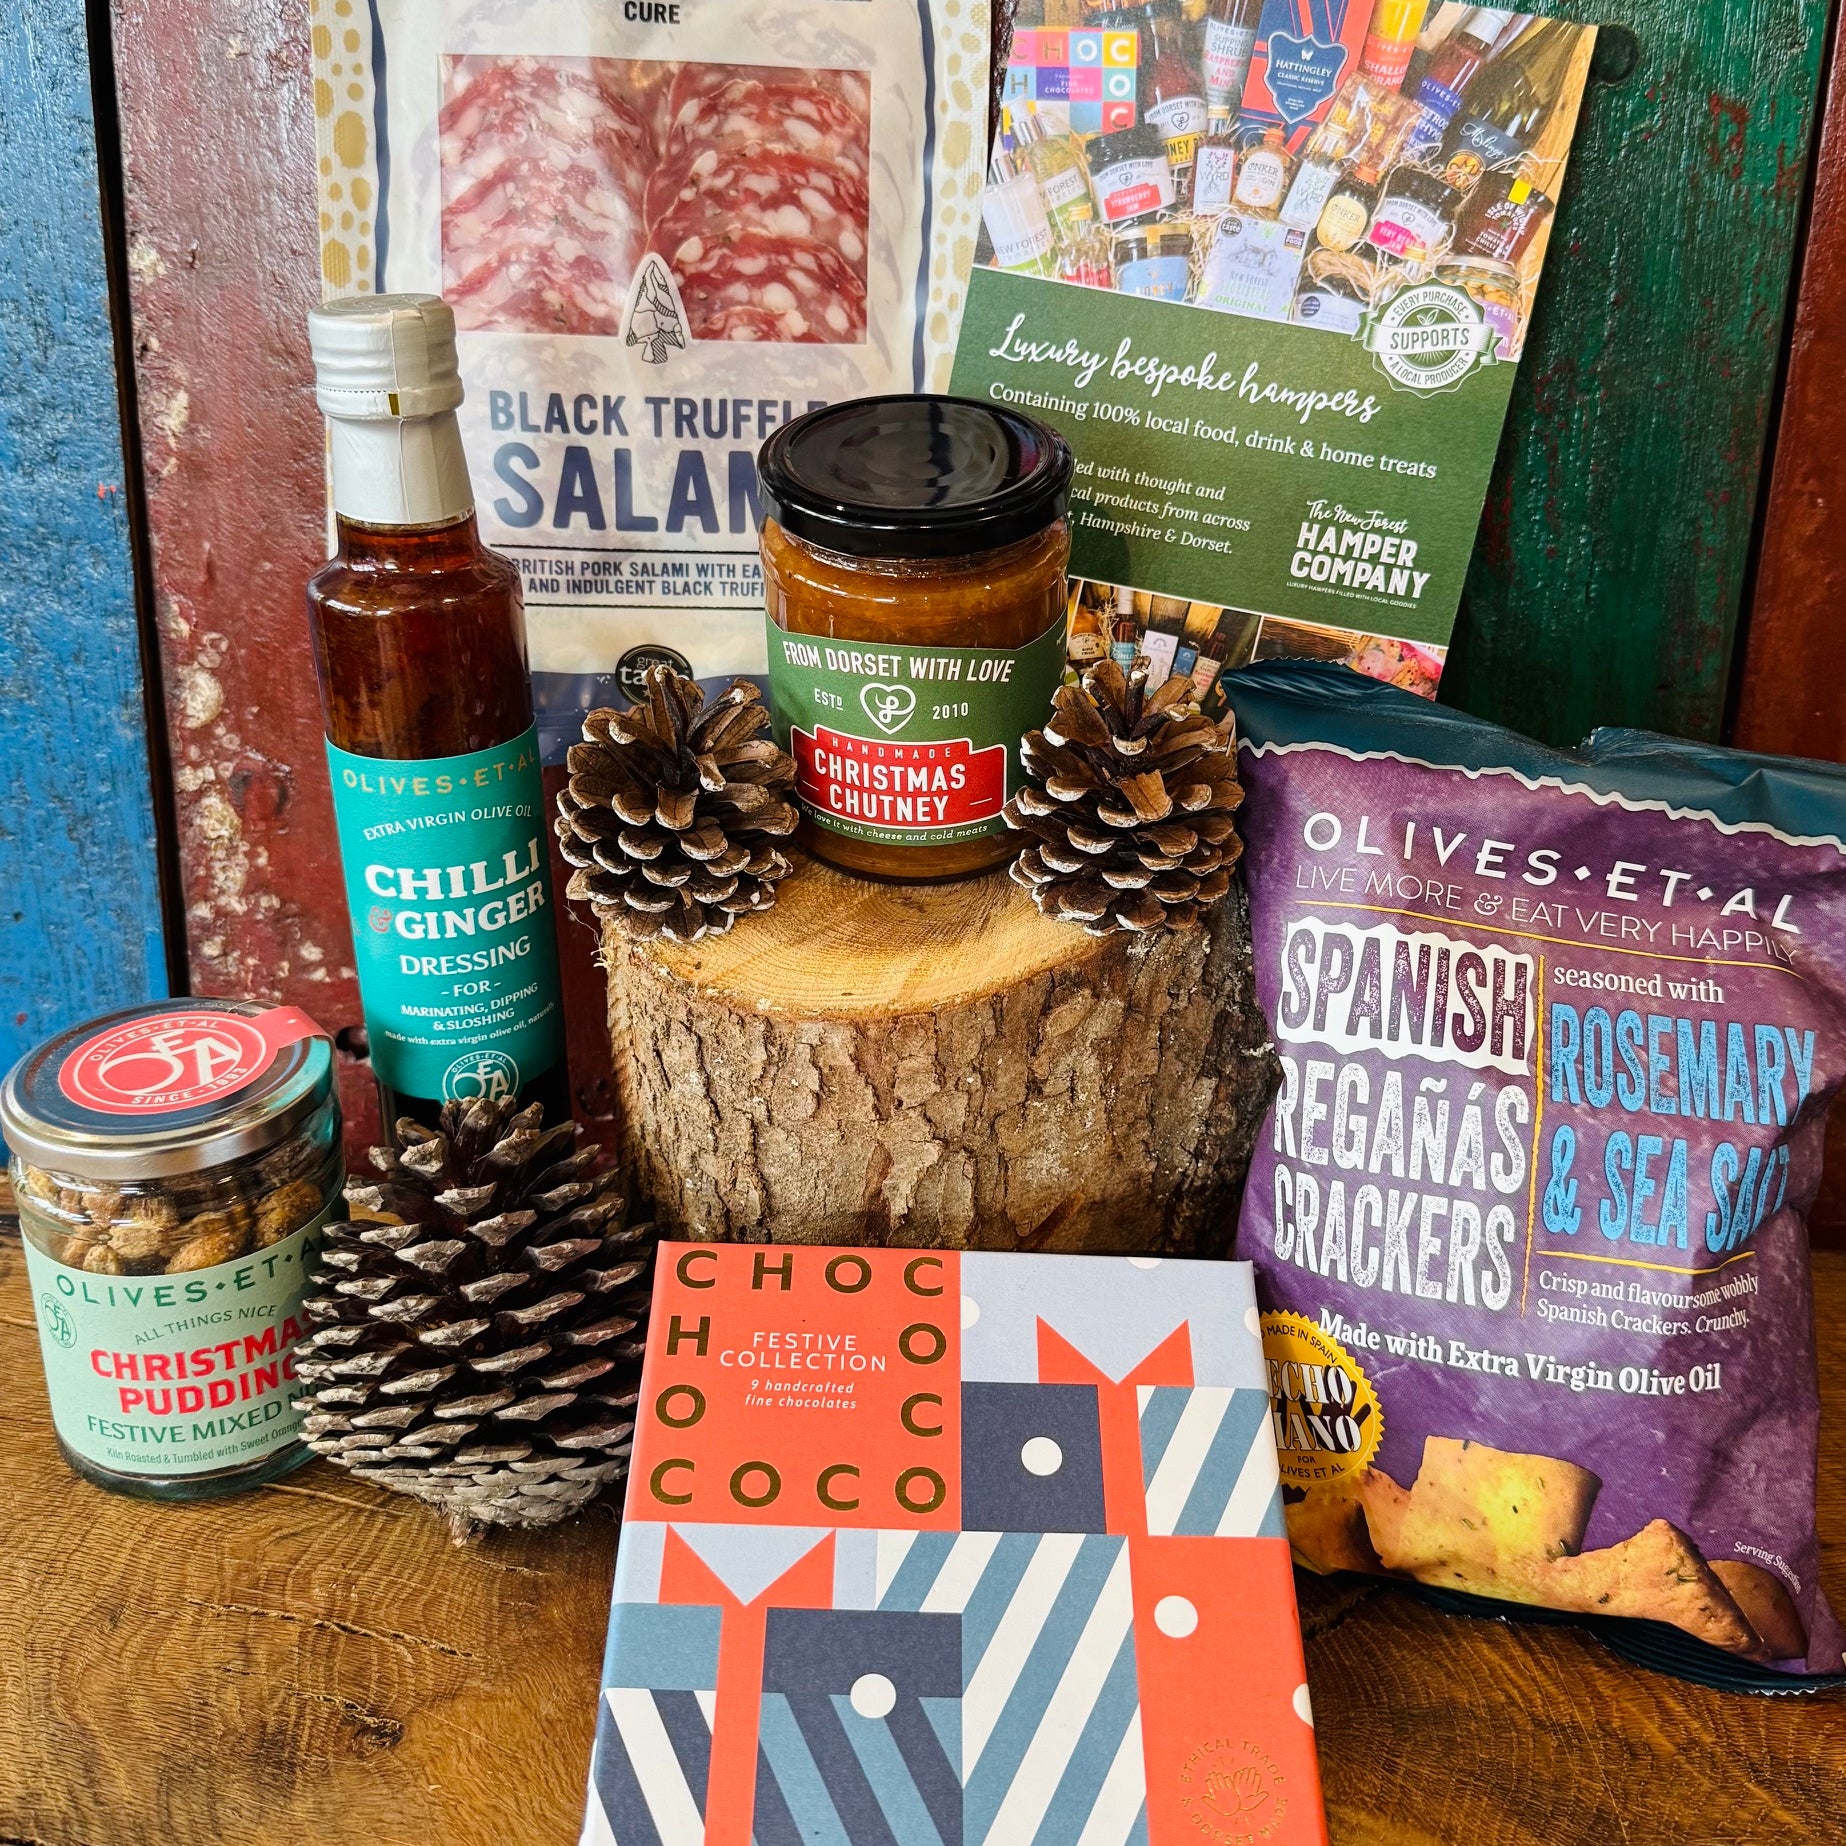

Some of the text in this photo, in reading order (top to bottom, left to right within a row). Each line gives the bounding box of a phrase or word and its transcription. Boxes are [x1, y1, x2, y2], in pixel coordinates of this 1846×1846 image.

[624, 1, 680, 24] CURE
[1276, 60, 1332, 78] HATTINGLEY
[1394, 291, 1467, 316] EVERY PURCHASE
[1390, 328, 1470, 350] SUPPORTS
[989, 312, 1382, 425] Luxury bespoke hampers
[1390, 357, 1468, 385] A LOCAL PRODUCER
[490, 390, 827, 440] BLACK TRUFF
[989, 383, 1437, 479] Containing 100% local food, drink & home treats
[1097, 466, 1226, 500] with thought and
[1094, 492, 1251, 532] products from across
[1307, 499, 1408, 534] The New Forest
[1080, 512, 1233, 554] Hampshire & Dorset.
[1297, 522, 1418, 567] HAMPER
[529, 579, 560, 594] AND
[567, 579, 655, 594] INDULGENT
[662, 582, 713, 596] BLACK
[581, 562, 622, 576] PORK
[630, 563, 689, 577] SALAMI
[695, 563, 736, 579] WITH
[1290, 551, 1431, 599] COMPANY
[1287, 581, 1308, 589] LUXURY
[1309, 585, 1335, 594] HAMPERS
[1336, 590, 1354, 598] FILLED
[1370, 596, 1388, 604] LOCAL
[1390, 599, 1417, 609] GOODIES
[782, 641, 1015, 682] FROM DORSET WITH LOVE
[932, 702, 969, 720] 2010
[832, 736, 951, 760] HANDMADE
[814, 749, 966, 792] CHRISTMAS
[830, 784, 949, 822] CHUTNEY
[363, 805, 532, 841] EXTRA VIRGIN OLIVE OIL
[814, 811, 831, 825] love
[834, 819, 840, 828] it
[842, 824, 864, 835] with
[867, 829, 902, 840] cheese
[906, 832, 927, 841] and
[930, 830, 953, 840] cold
[957, 825, 987, 837] meats
[365, 838, 540, 900] CHILLI
[369, 881, 545, 939] & GINGER
[1295, 864, 1800, 966] LIVE MORE & EAT VERY HAPPILY
[400, 935, 531, 976] DRESSING
[402, 983, 538, 1017] MARINATING, DIPPING
[1280, 926, 1529, 1060] SPANISH
[1553, 964, 1725, 1003] seasoned with
[385, 1021, 527, 1046] made with extra virgin olive oil,
[433, 1009, 515, 1031] & SLOSHING
[1551, 1003, 1815, 1128] ROSEMARY
[1273, 1057, 1530, 1194] REGAÑÁS
[1542, 1124, 1580, 1237] &
[1602, 1131, 1687, 1250] SEA
[1273, 1162, 1516, 1312] CRACKERS
[1539, 1271, 1759, 1309] Crisp and flavoursome wobbly
[135, 1304, 278, 1345] ALL THINGS NICE
[1537, 1299, 1750, 1335] Spanish Crackers. Crunchy.
[720, 1350, 887, 1371] COLLECTION
[753, 1332, 857, 1351] FESTIVE
[1267, 1325, 1337, 1363] MADE IN SPAIN
[1320, 1308, 1721, 1396] Made with Extra Virgin Olive Oil
[745, 1394, 857, 1409] fine chocolates
[751, 1379, 854, 1394] 9 handcrafted
[88, 1400, 282, 1443] FESTIVE MIXED
[125, 1452, 162, 1464] Roasted
[164, 1454, 170, 1463] &
[172, 1450, 214, 1464] Tumbled
[216, 1443, 238, 1458] with
[240, 1434, 269, 1450] Sweet
[1298, 1455, 1316, 1463] FOR
[1280, 1463, 1345, 1478] LIVES ET AL
[1734, 1541, 1801, 1594] Serving Suggestion
[1181, 1738, 1286, 1785] ETHICAL TRADE
